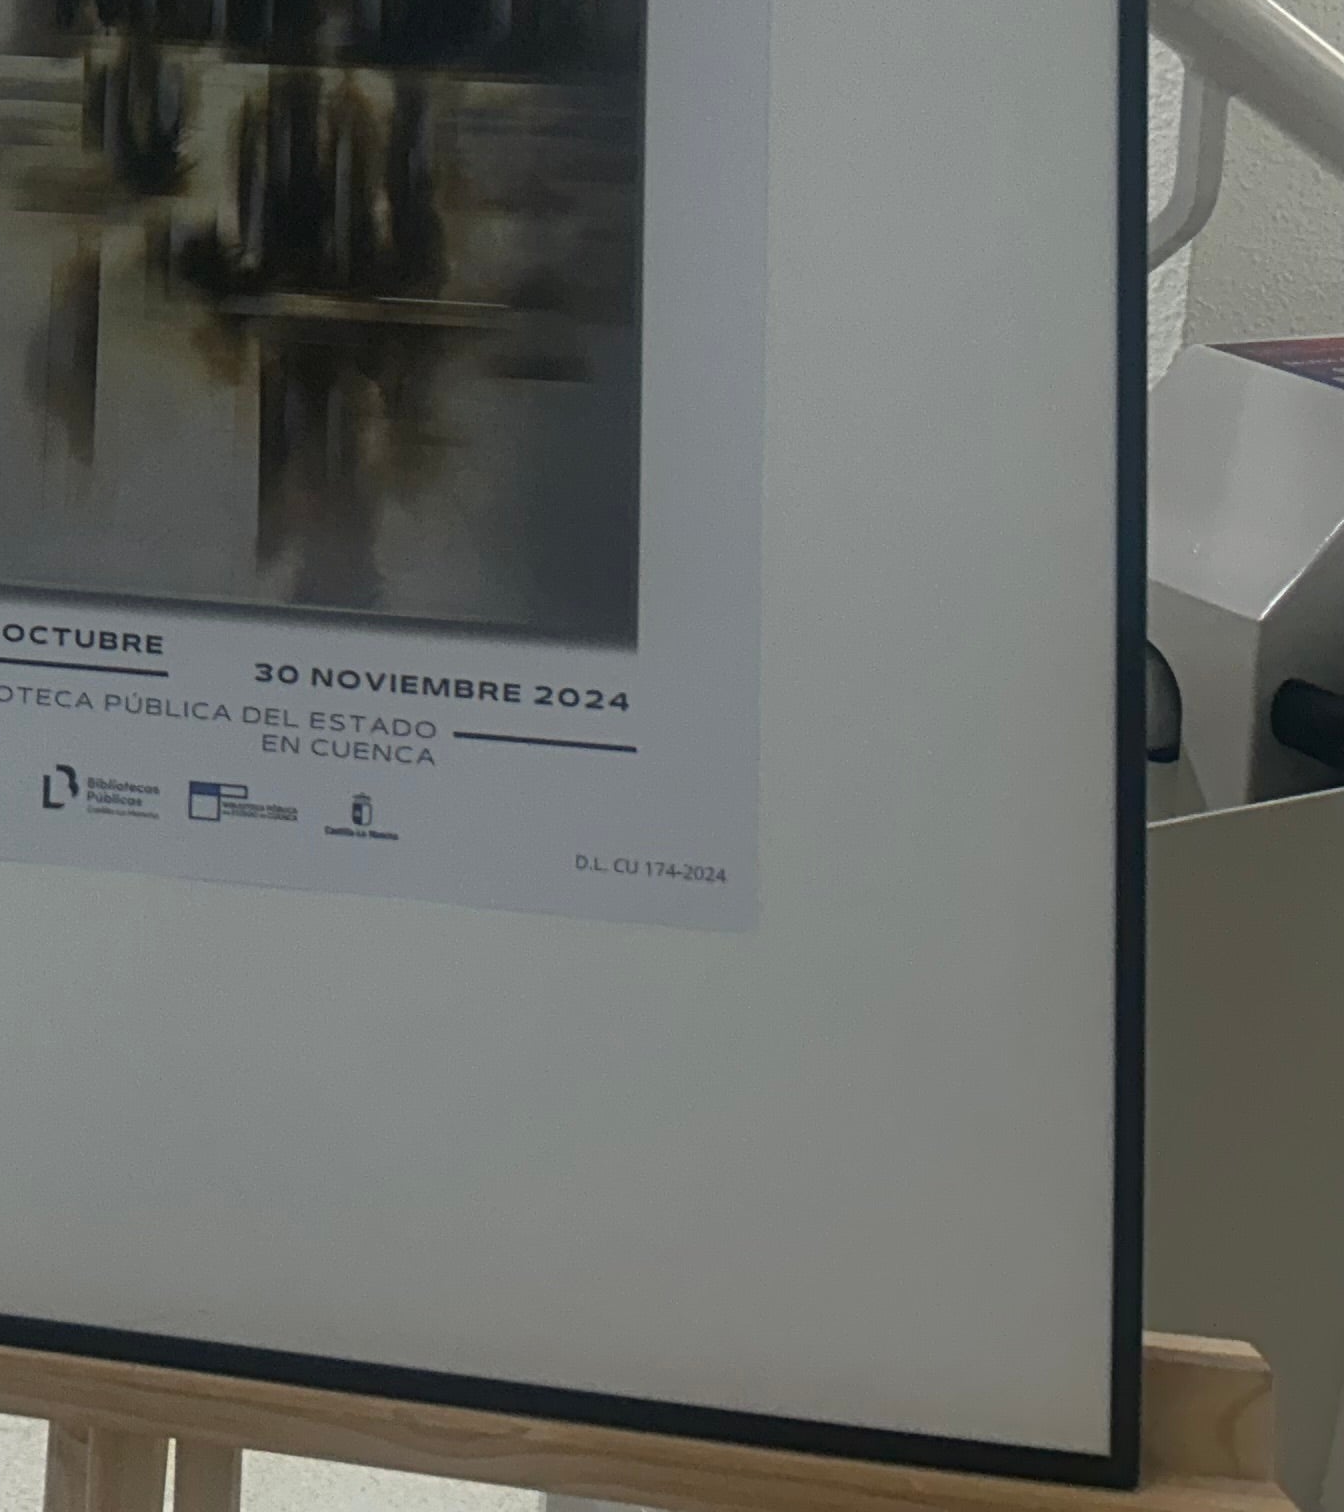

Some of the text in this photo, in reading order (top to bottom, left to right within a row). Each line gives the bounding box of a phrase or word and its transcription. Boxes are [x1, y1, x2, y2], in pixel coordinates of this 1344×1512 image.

[2, 623, 164, 655] OCTUBRE
[254, 663, 630, 712] 30 NOVIEMBRE 2024
[105, 692, 232, 722] PÚBLICA
[242, 705, 299, 729] DEL
[310, 712, 438, 739] ESTADO
[262, 734, 436, 766] EN CUENCA
[614, 858, 639, 875] CU
[645, 860, 728, 884] 174-2024
